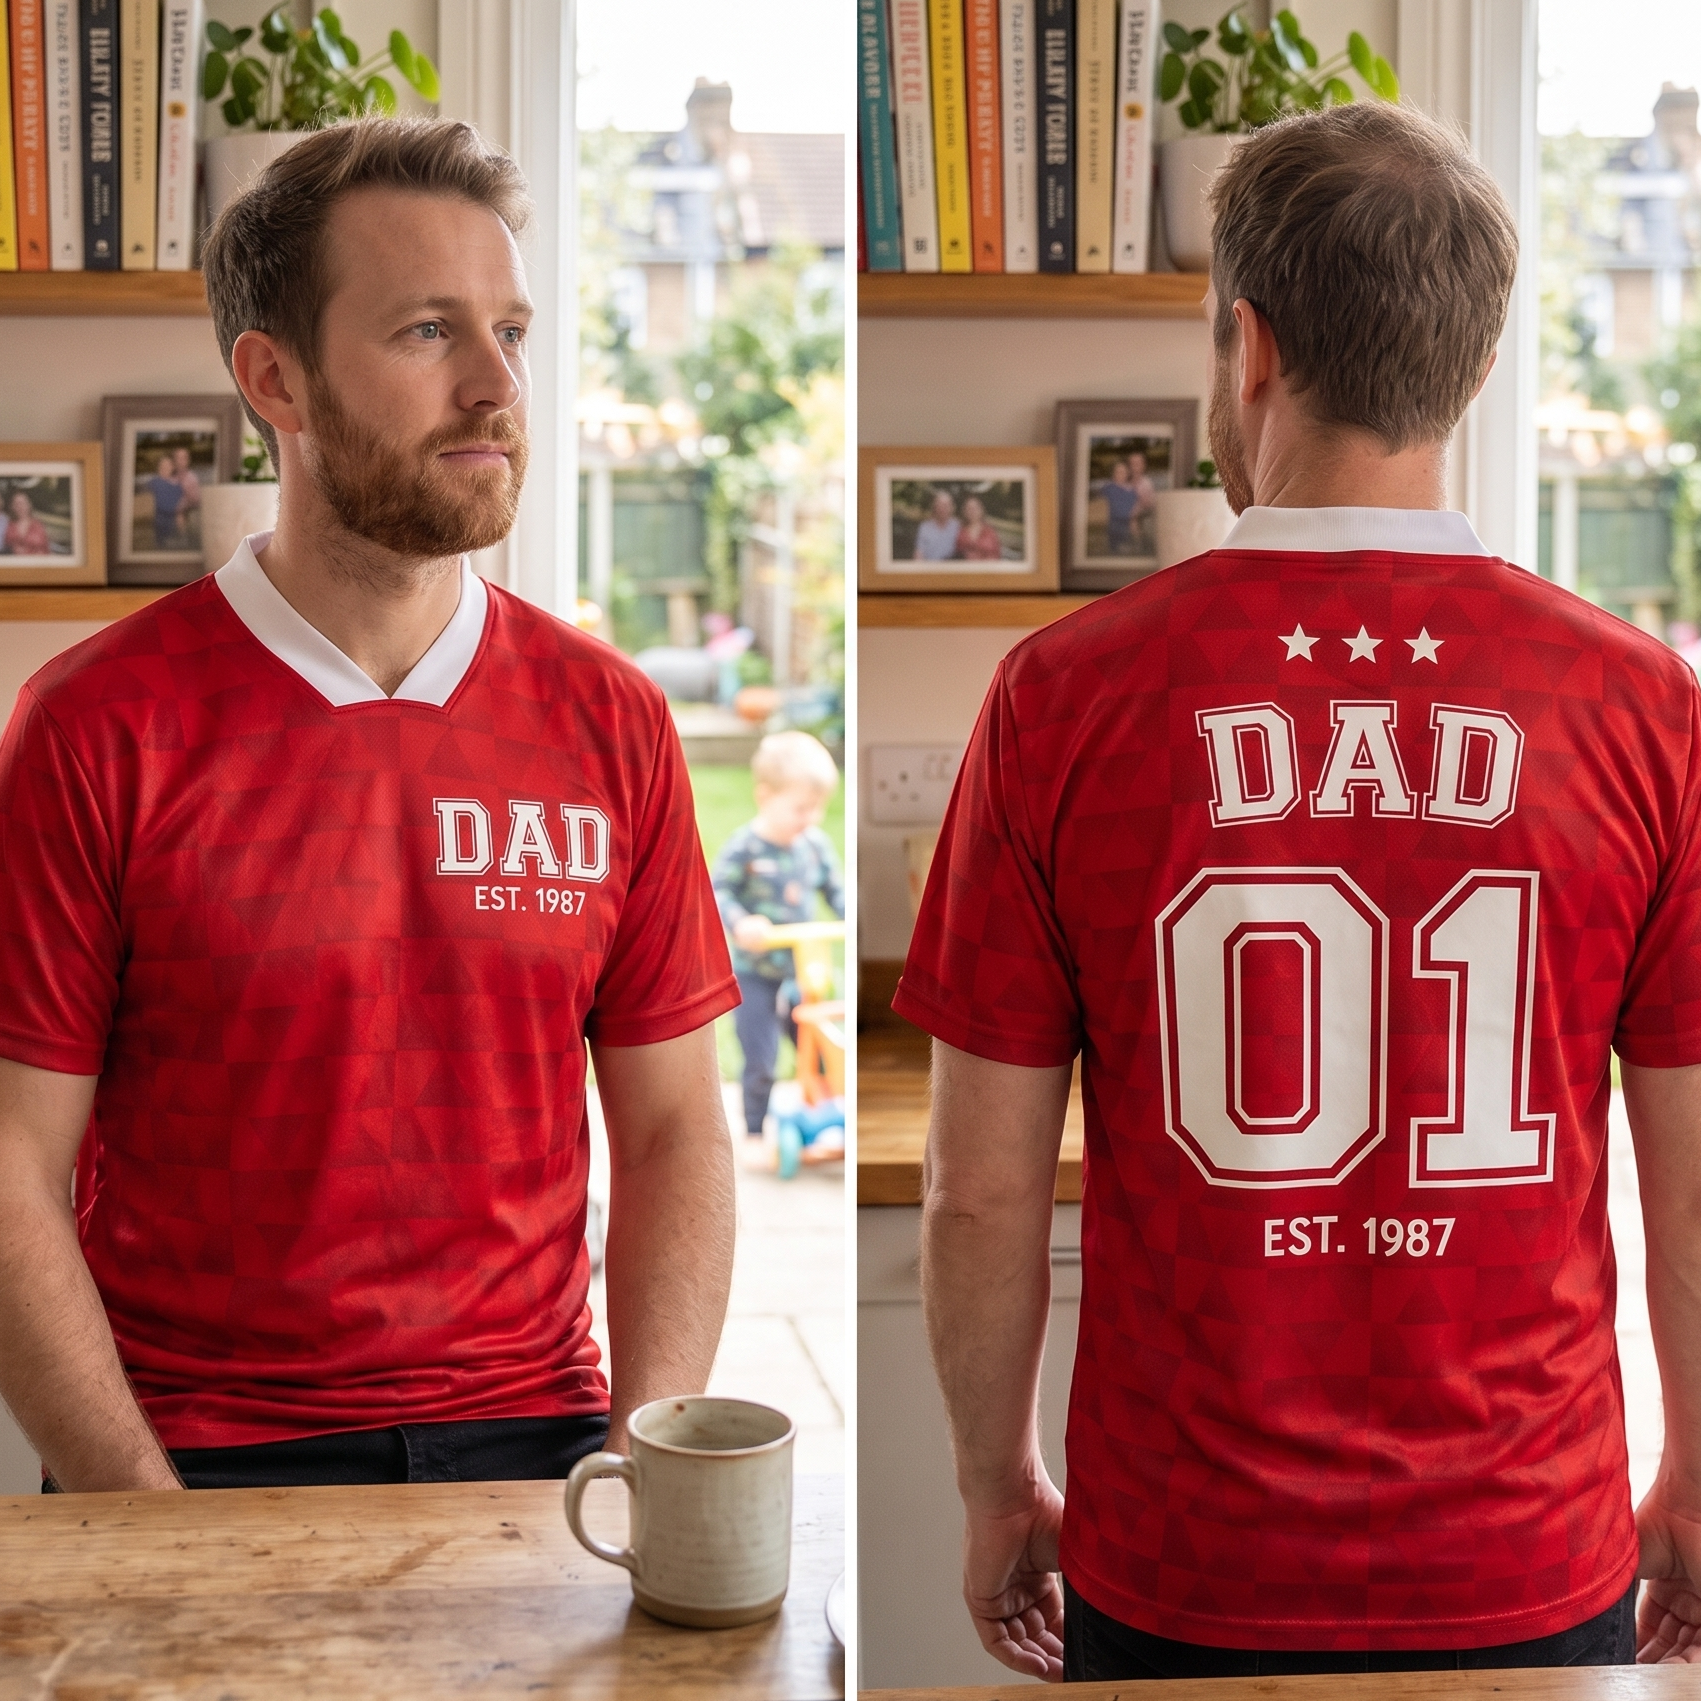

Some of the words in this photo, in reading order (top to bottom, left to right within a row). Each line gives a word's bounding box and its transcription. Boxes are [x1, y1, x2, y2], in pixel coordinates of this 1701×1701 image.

[1194, 699, 1526, 830] DAD
[432, 797, 611, 884] DAD
[474, 885, 527, 912] EST.
[535, 887, 586, 916] 1987
[1154, 866, 1557, 1190] 01
[1264, 1215, 1346, 1257] EST.
[1362, 1217, 1456, 1258] 1987
